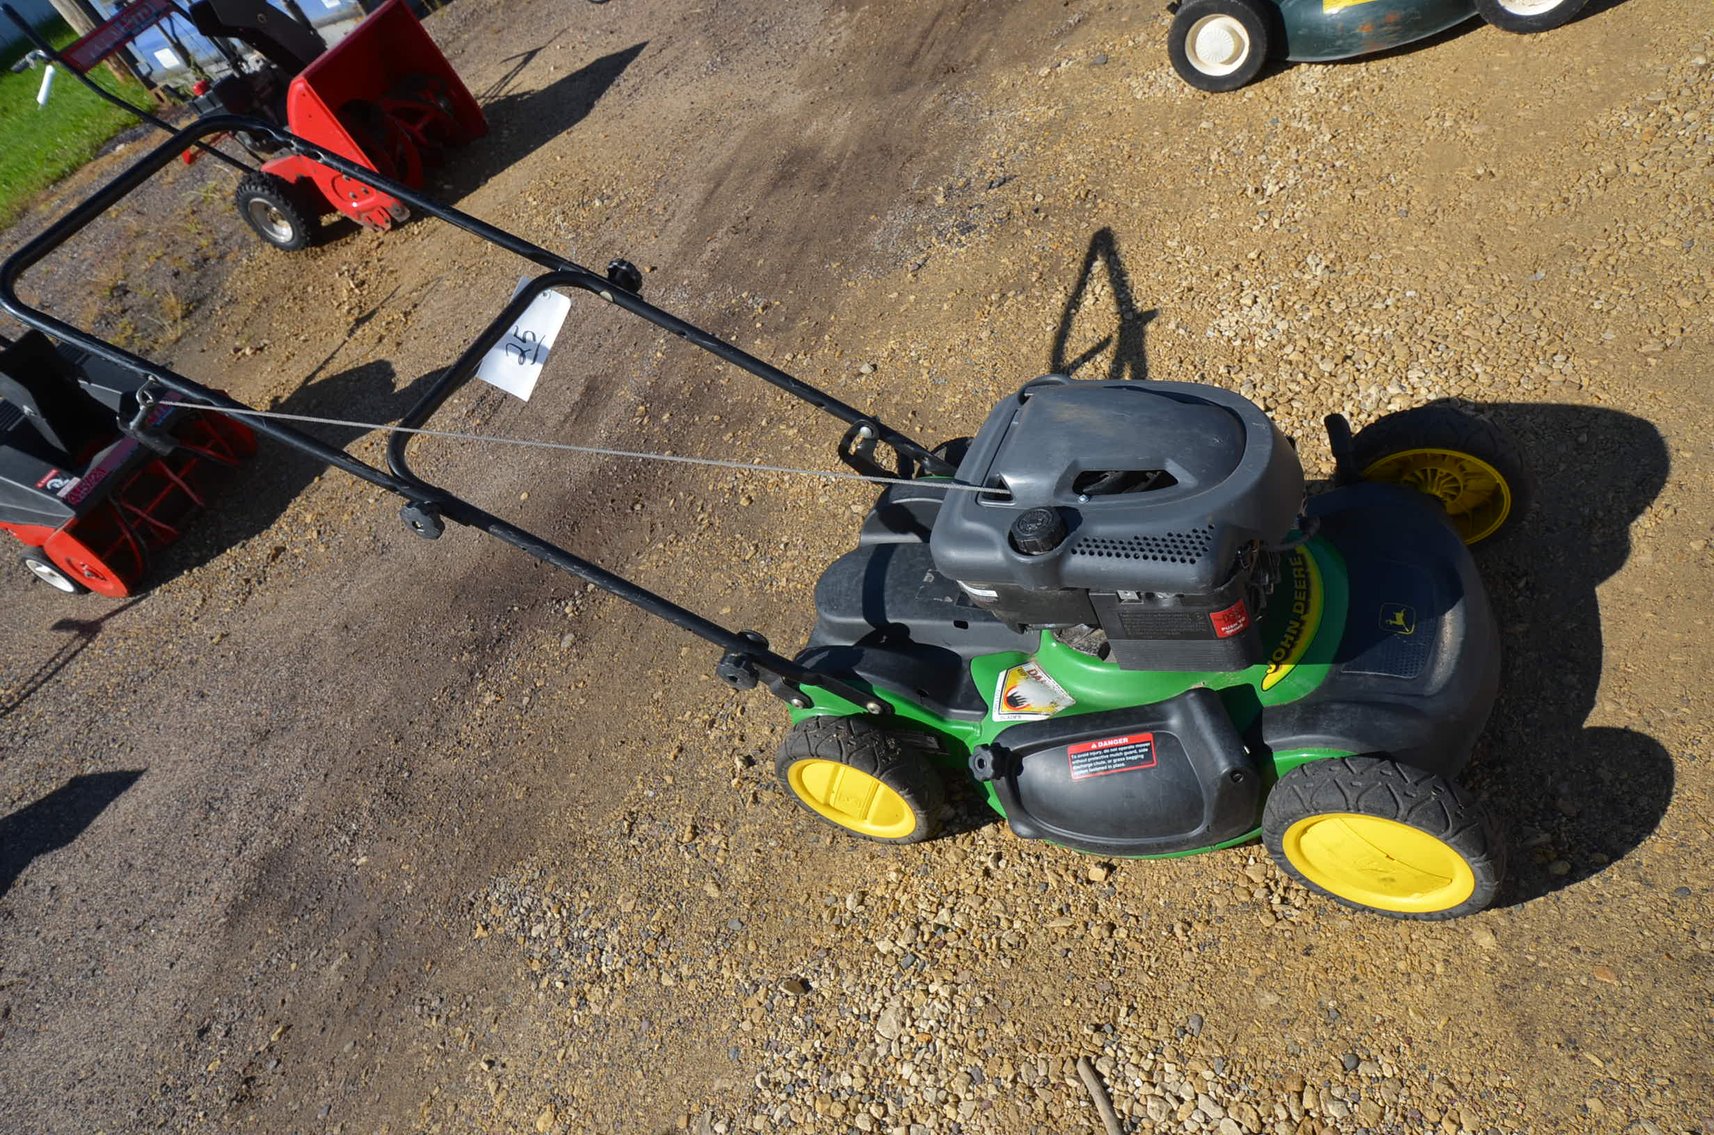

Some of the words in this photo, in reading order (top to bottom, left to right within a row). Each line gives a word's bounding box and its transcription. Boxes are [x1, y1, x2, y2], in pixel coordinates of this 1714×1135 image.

[505, 325, 536, 366] 25
[1266, 619, 1300, 674] JOHN
[1290, 553, 1306, 614] DEERE
[1098, 737, 1128, 747] DANGER
